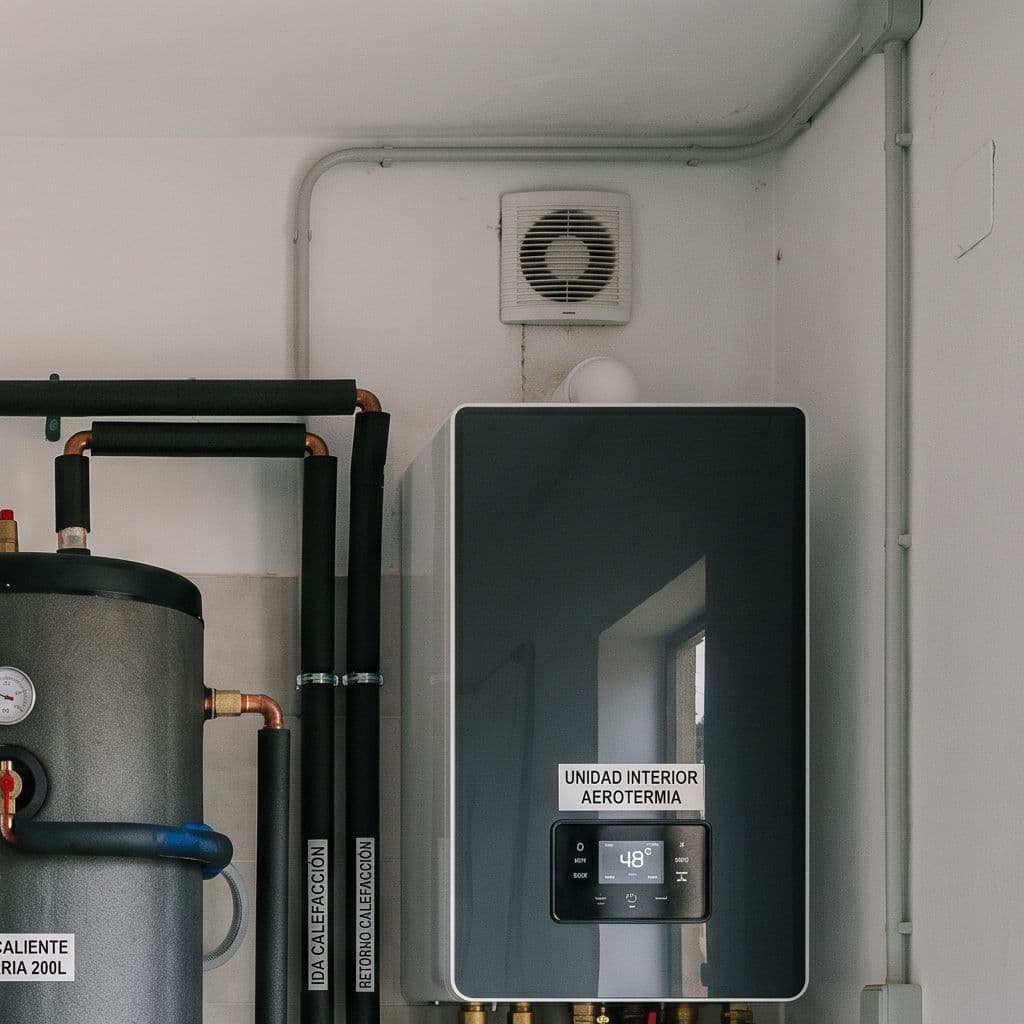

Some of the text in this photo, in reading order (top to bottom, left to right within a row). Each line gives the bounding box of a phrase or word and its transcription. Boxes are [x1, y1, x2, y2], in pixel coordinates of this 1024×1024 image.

[565, 770, 698, 785] UNIDAD INTERIOR
[581, 790, 682, 804] AEROTERMIA
[359, 931, 372, 988] RETORNO
[31, 960, 66, 975] 200L
[311, 960, 325, 985] IDA
